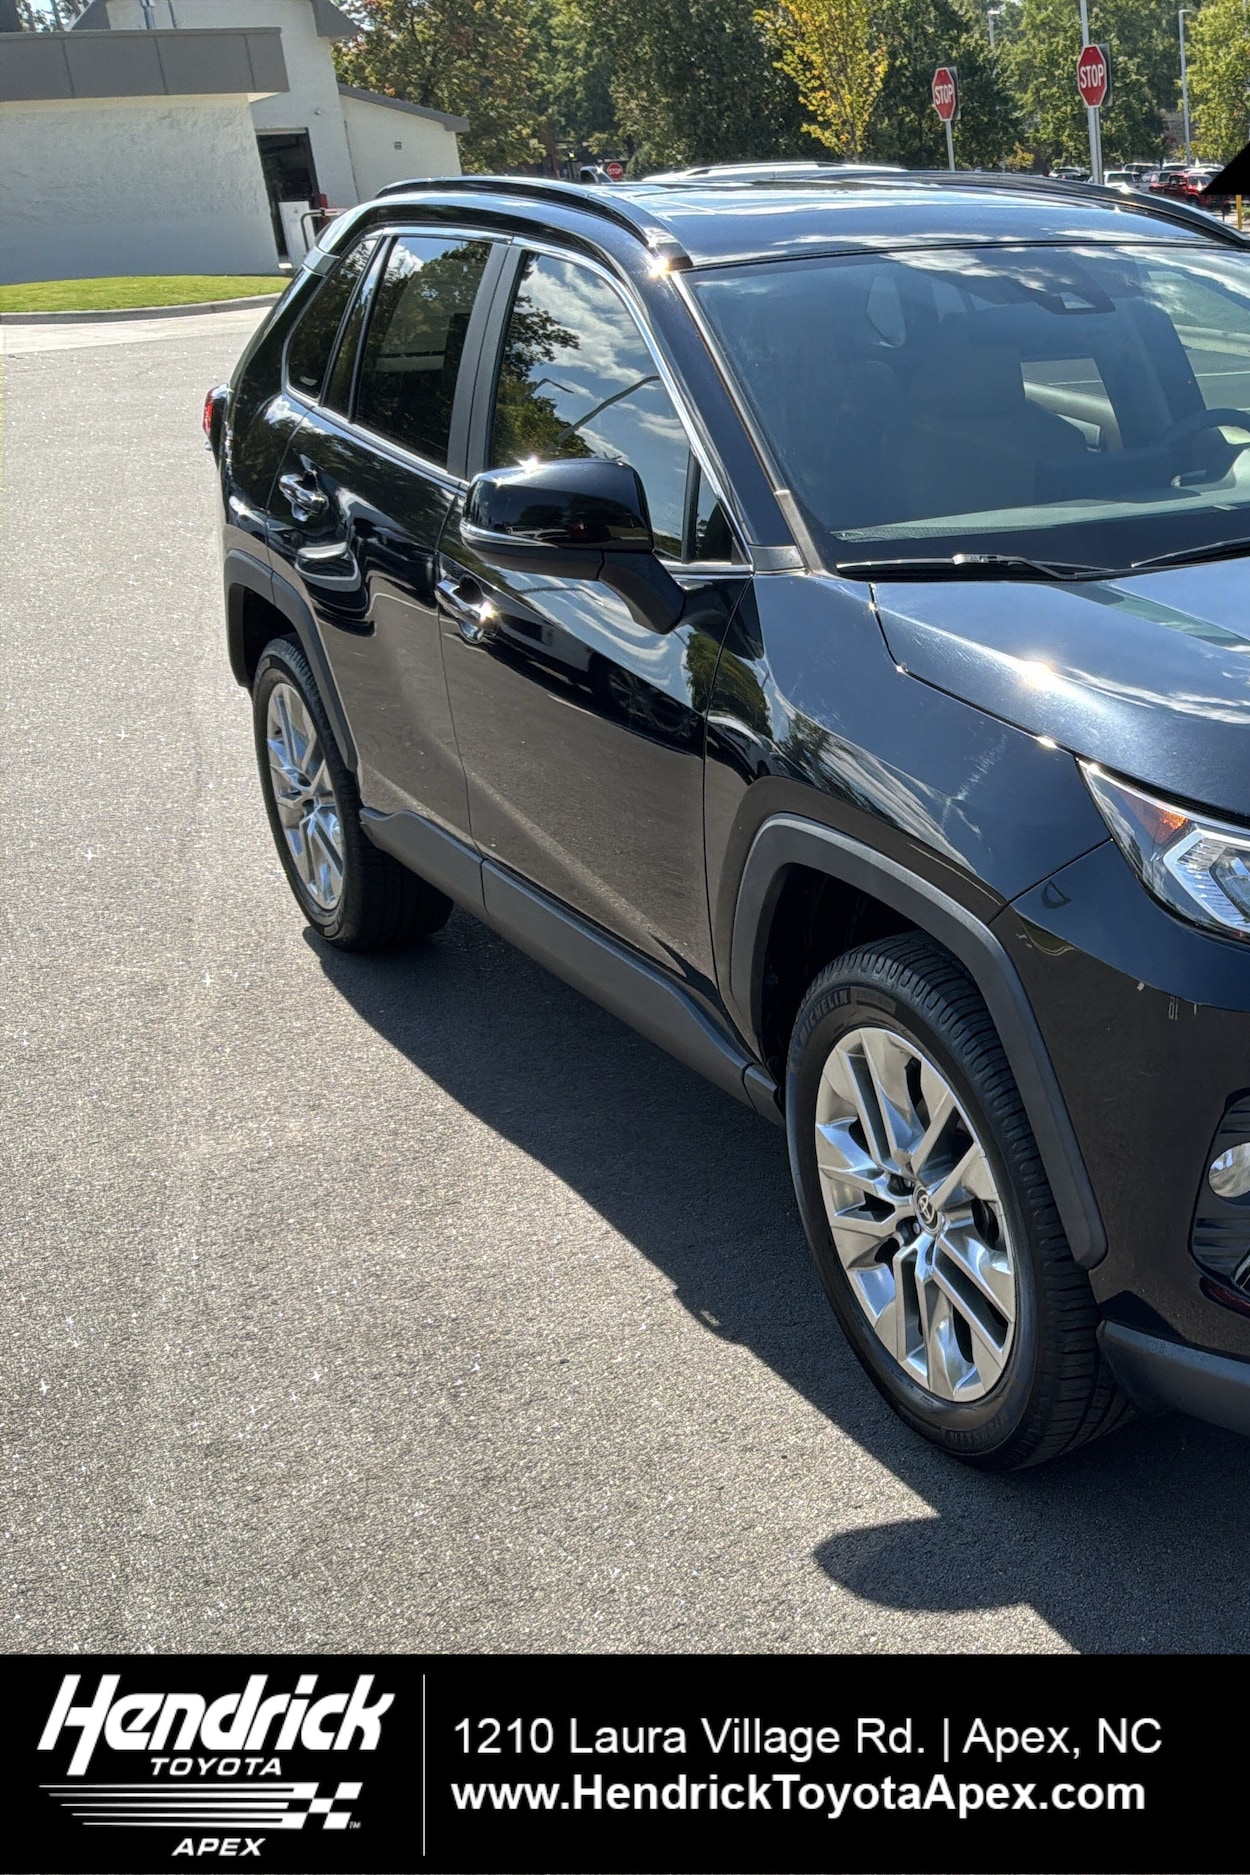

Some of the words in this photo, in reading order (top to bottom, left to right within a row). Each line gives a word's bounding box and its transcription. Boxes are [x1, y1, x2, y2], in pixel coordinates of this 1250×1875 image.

[1080, 64, 1104, 89] STOP
[935, 84, 953, 105] STOP
[799, 988, 850, 1047] MICHELIN
